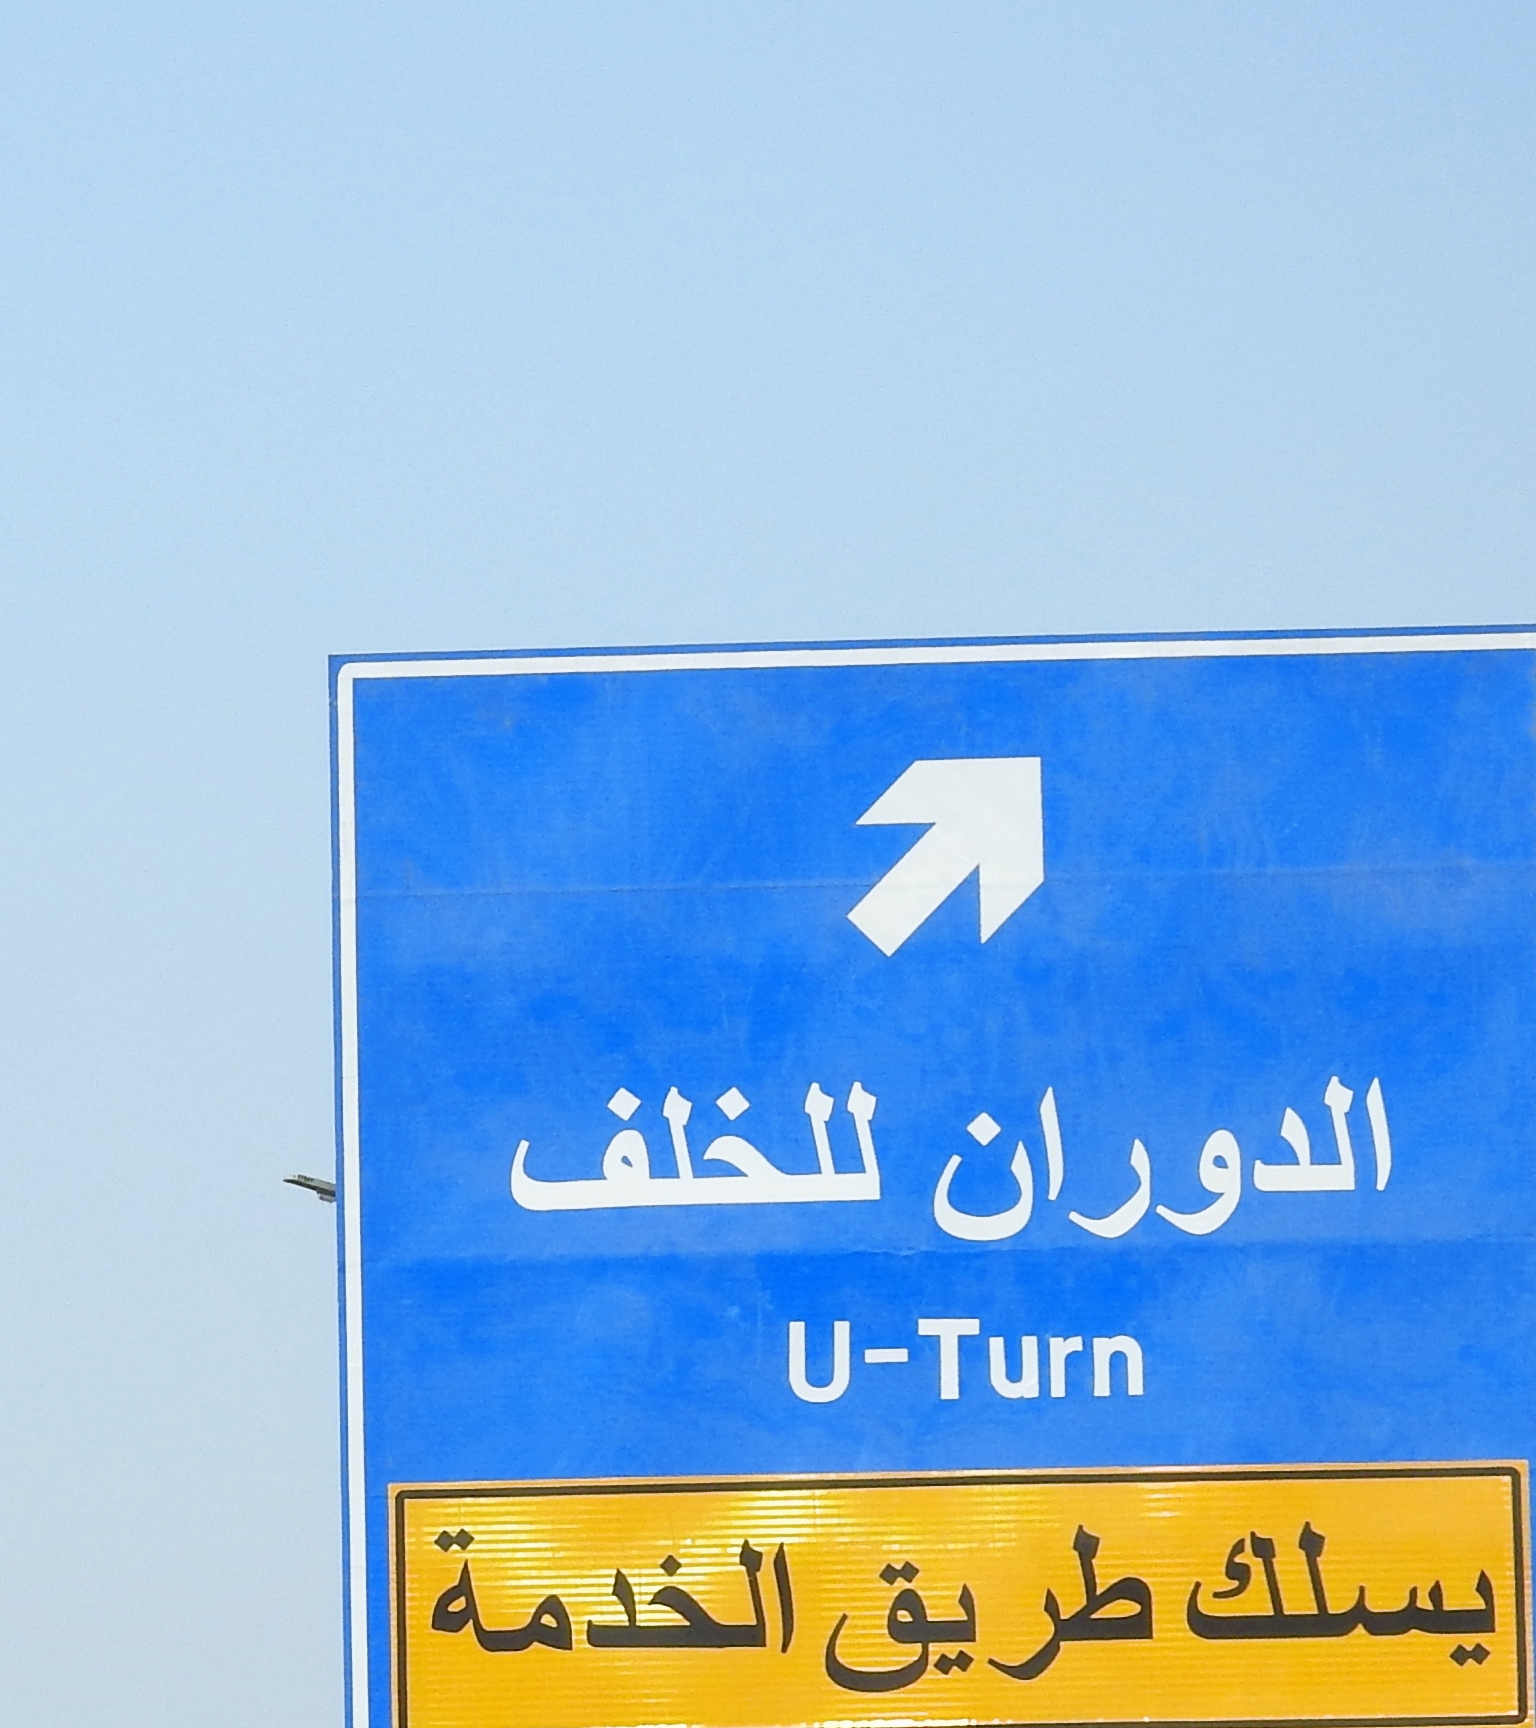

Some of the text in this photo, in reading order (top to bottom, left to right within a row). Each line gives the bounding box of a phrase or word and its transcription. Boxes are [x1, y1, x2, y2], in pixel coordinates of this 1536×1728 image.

[510, 1075, 1393, 1241] الدوران للخلف
[787, 1317, 1145, 1404] U-Turn
[430, 1521, 1497, 1694] يسلك طريق الخدمة
